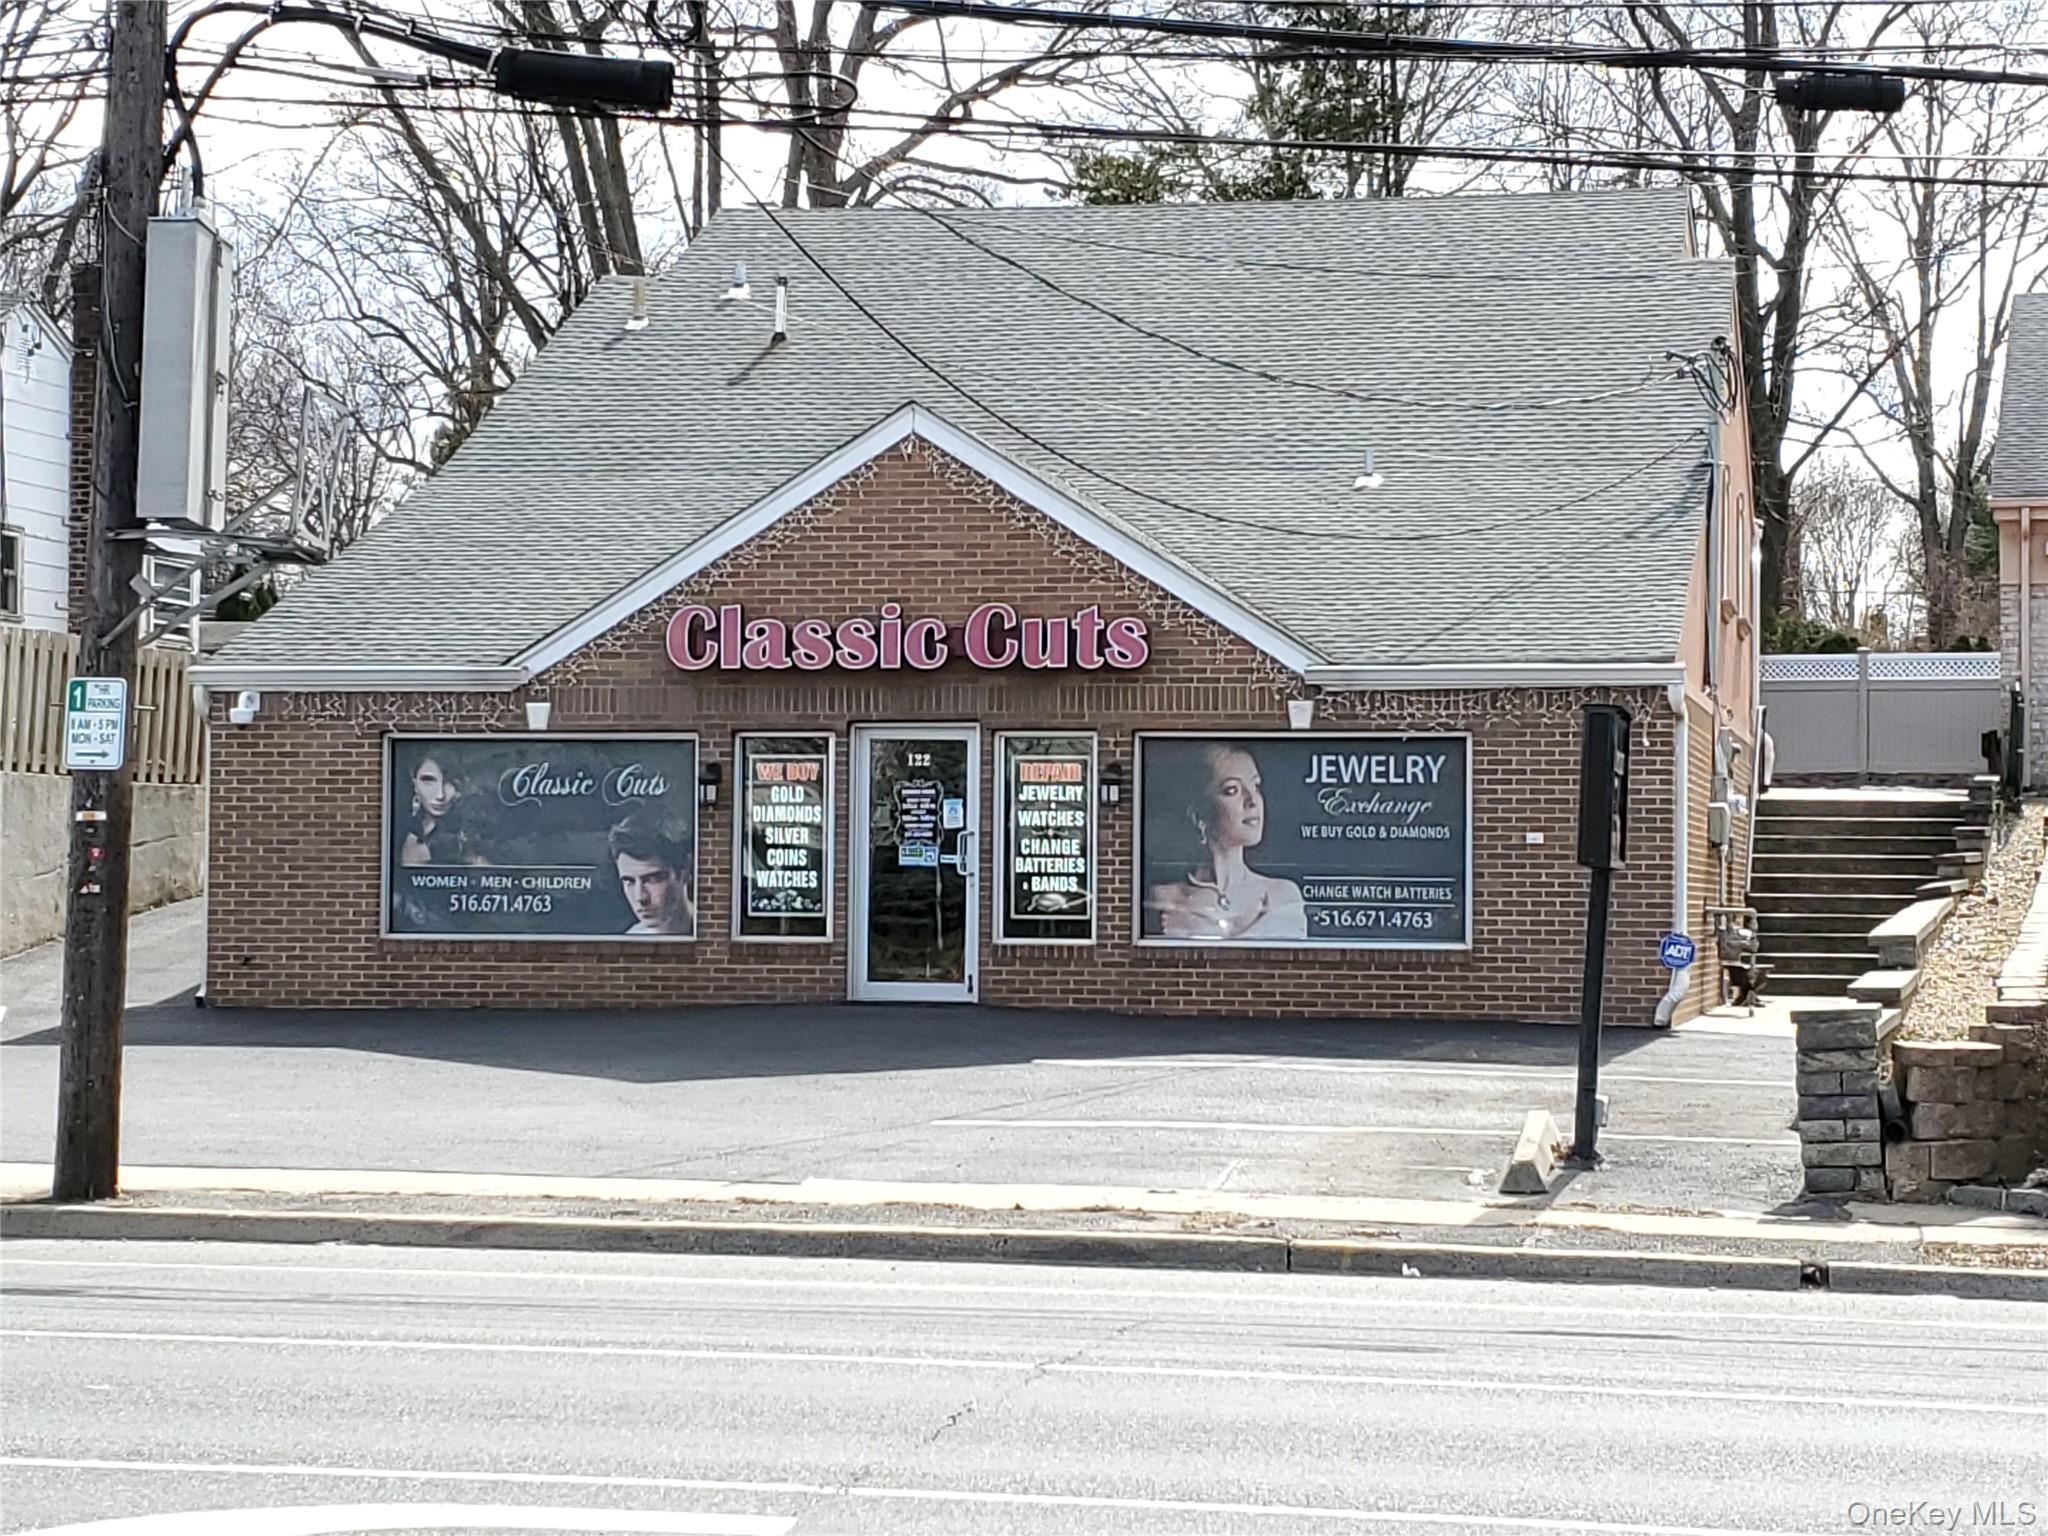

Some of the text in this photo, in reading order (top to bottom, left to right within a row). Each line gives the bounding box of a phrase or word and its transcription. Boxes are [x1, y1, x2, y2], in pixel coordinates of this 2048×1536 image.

[666, 602, 1150, 670] Classic Cuts
[73, 686, 82, 709] 1
[88, 698, 120, 709] PARKING
[77, 718, 91, 730] AM
[98, 719, 105, 730] 5
[106, 719, 119, 730] PM
[71, 733, 91, 745] MON
[99, 733, 116, 745] SAT
[907, 753, 931, 766] 122
[756, 762, 820, 780] WE BUY
[1019, 762, 1082, 782] REPAIR
[1304, 754, 1447, 784] JEWELRY
[498, 761, 671, 807] Classic Cuts
[771, 786, 804, 803] GOLD
[1018, 785, 1084, 802] JEWELRY
[753, 805, 822, 823] DIAMONDS
[1317, 788, 1433, 824] Exchange
[1017, 810, 1084, 827] WATCHES
[765, 827, 809, 845] SILVER
[1301, 826, 1451, 839] WE BUY GOLD & DIAMONDS
[1020, 838, 1081, 855] CHANGE
[766, 848, 807, 866] COINS
[1015, 857, 1085, 874] BATTERIES
[412, 875, 592, 890] WOMEN MEN CHILDREN
[756, 870, 818, 888] WATCHES
[1031, 876, 1078, 892] BANDS
[1303, 885, 1453, 900] CHANGE WATCH BATTERIES
[449, 894, 552, 913] 516.671.4763
[1319, 910, 1433, 929] 516.671.4763
[1665, 944, 1692, 959] ADT
